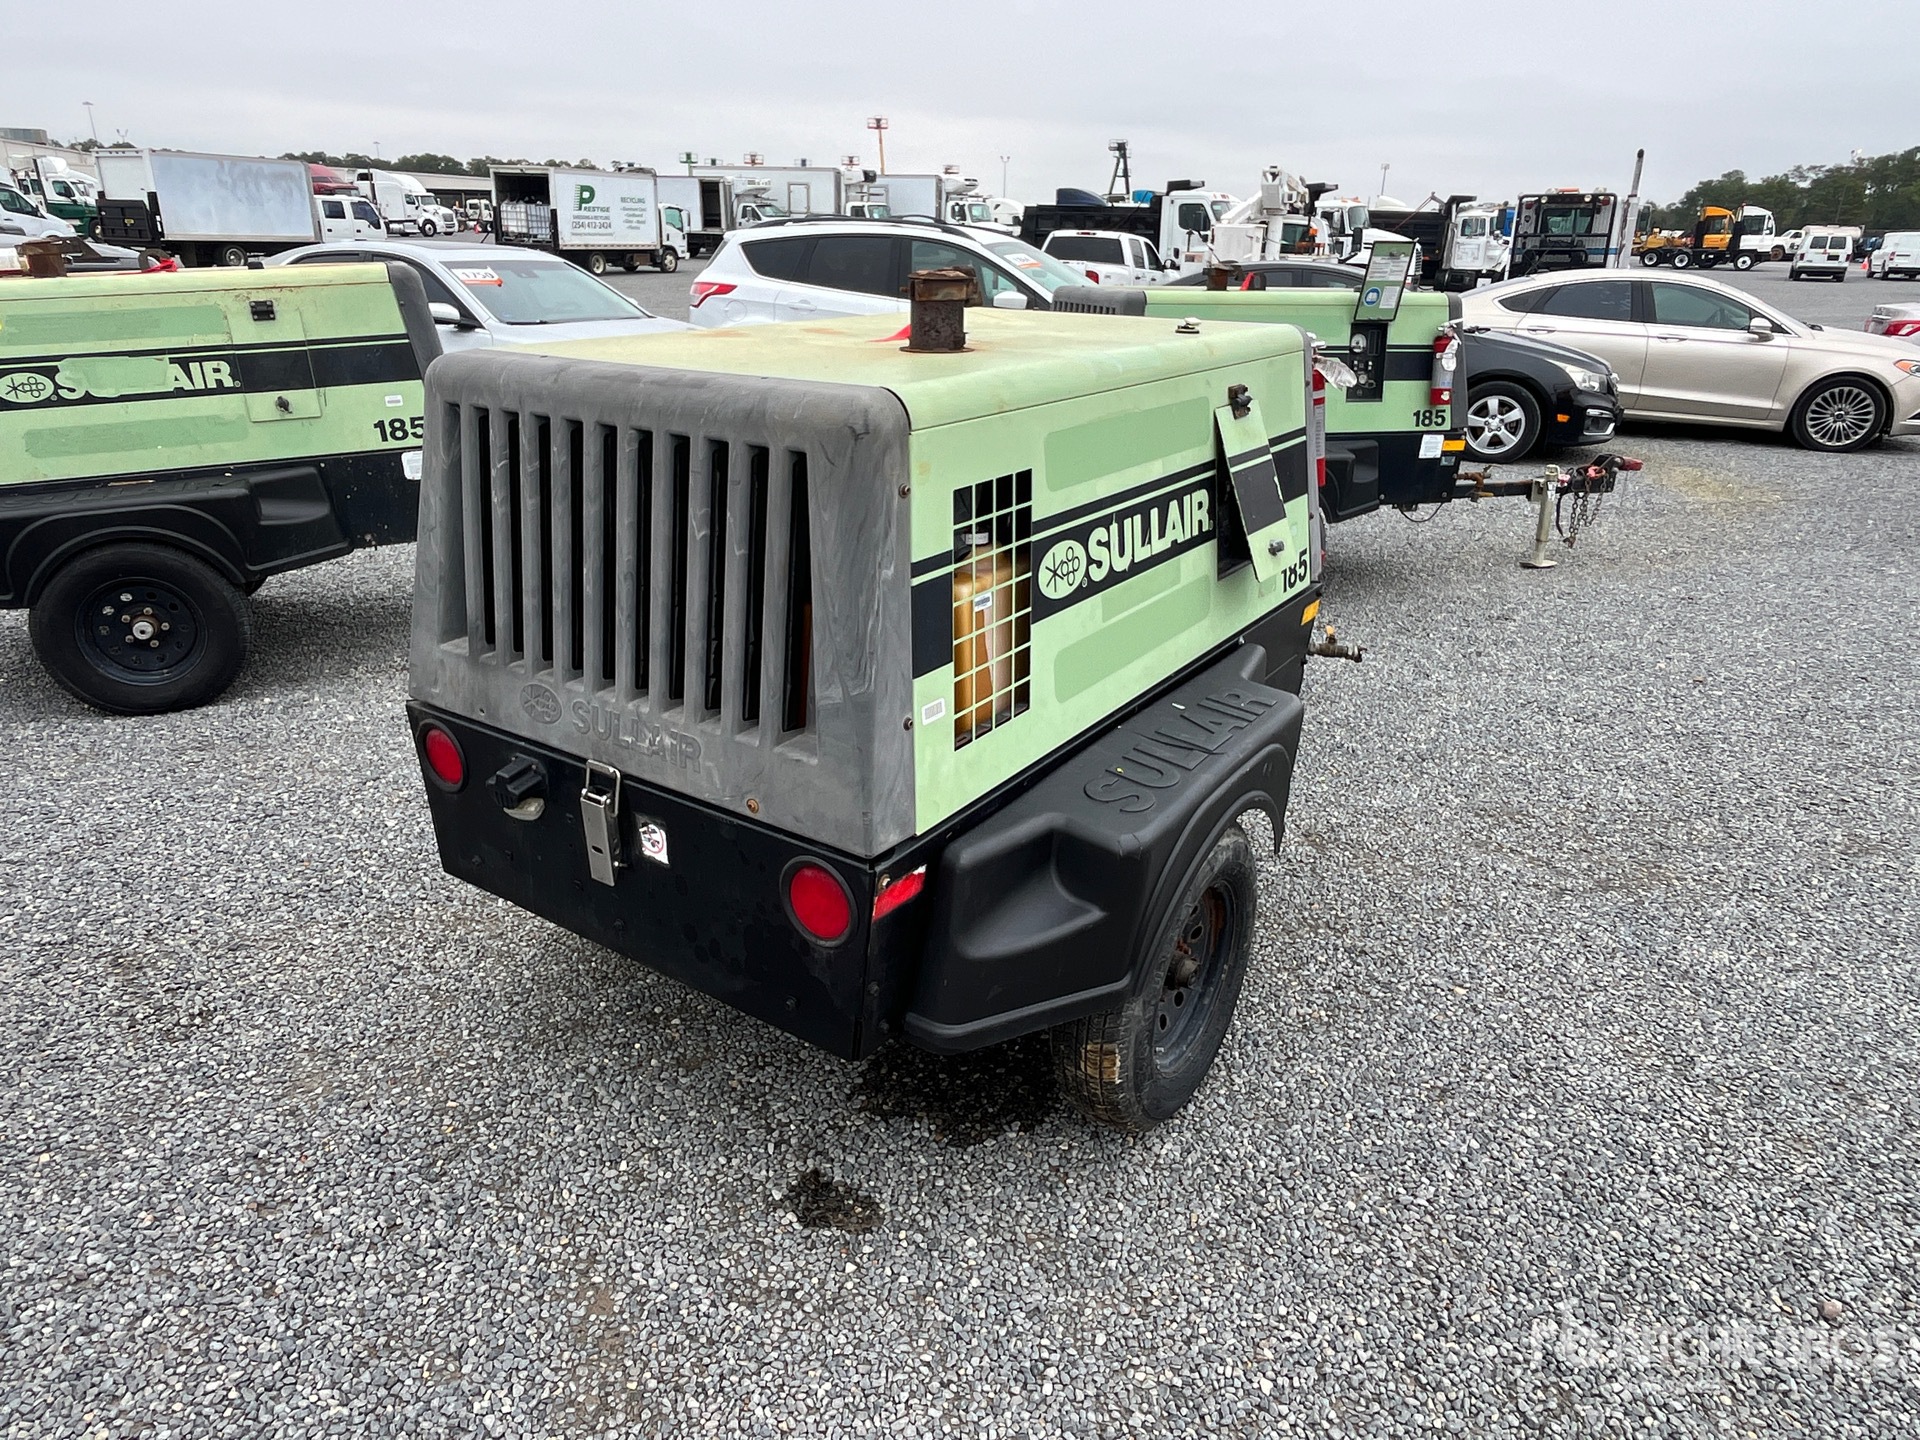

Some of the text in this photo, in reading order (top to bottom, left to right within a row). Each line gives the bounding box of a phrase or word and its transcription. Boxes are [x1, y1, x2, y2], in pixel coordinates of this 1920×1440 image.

[620, 196, 646, 204] RECYCLING
[373, 416, 424, 442] 185
[1413, 409, 1446, 427] 185
[1088, 488, 1210, 582] SULLAIR
[1280, 547, 1308, 593] 185
[571, 699, 702, 774] SULLAIR
[1083, 687, 1279, 813] SULLAIR
